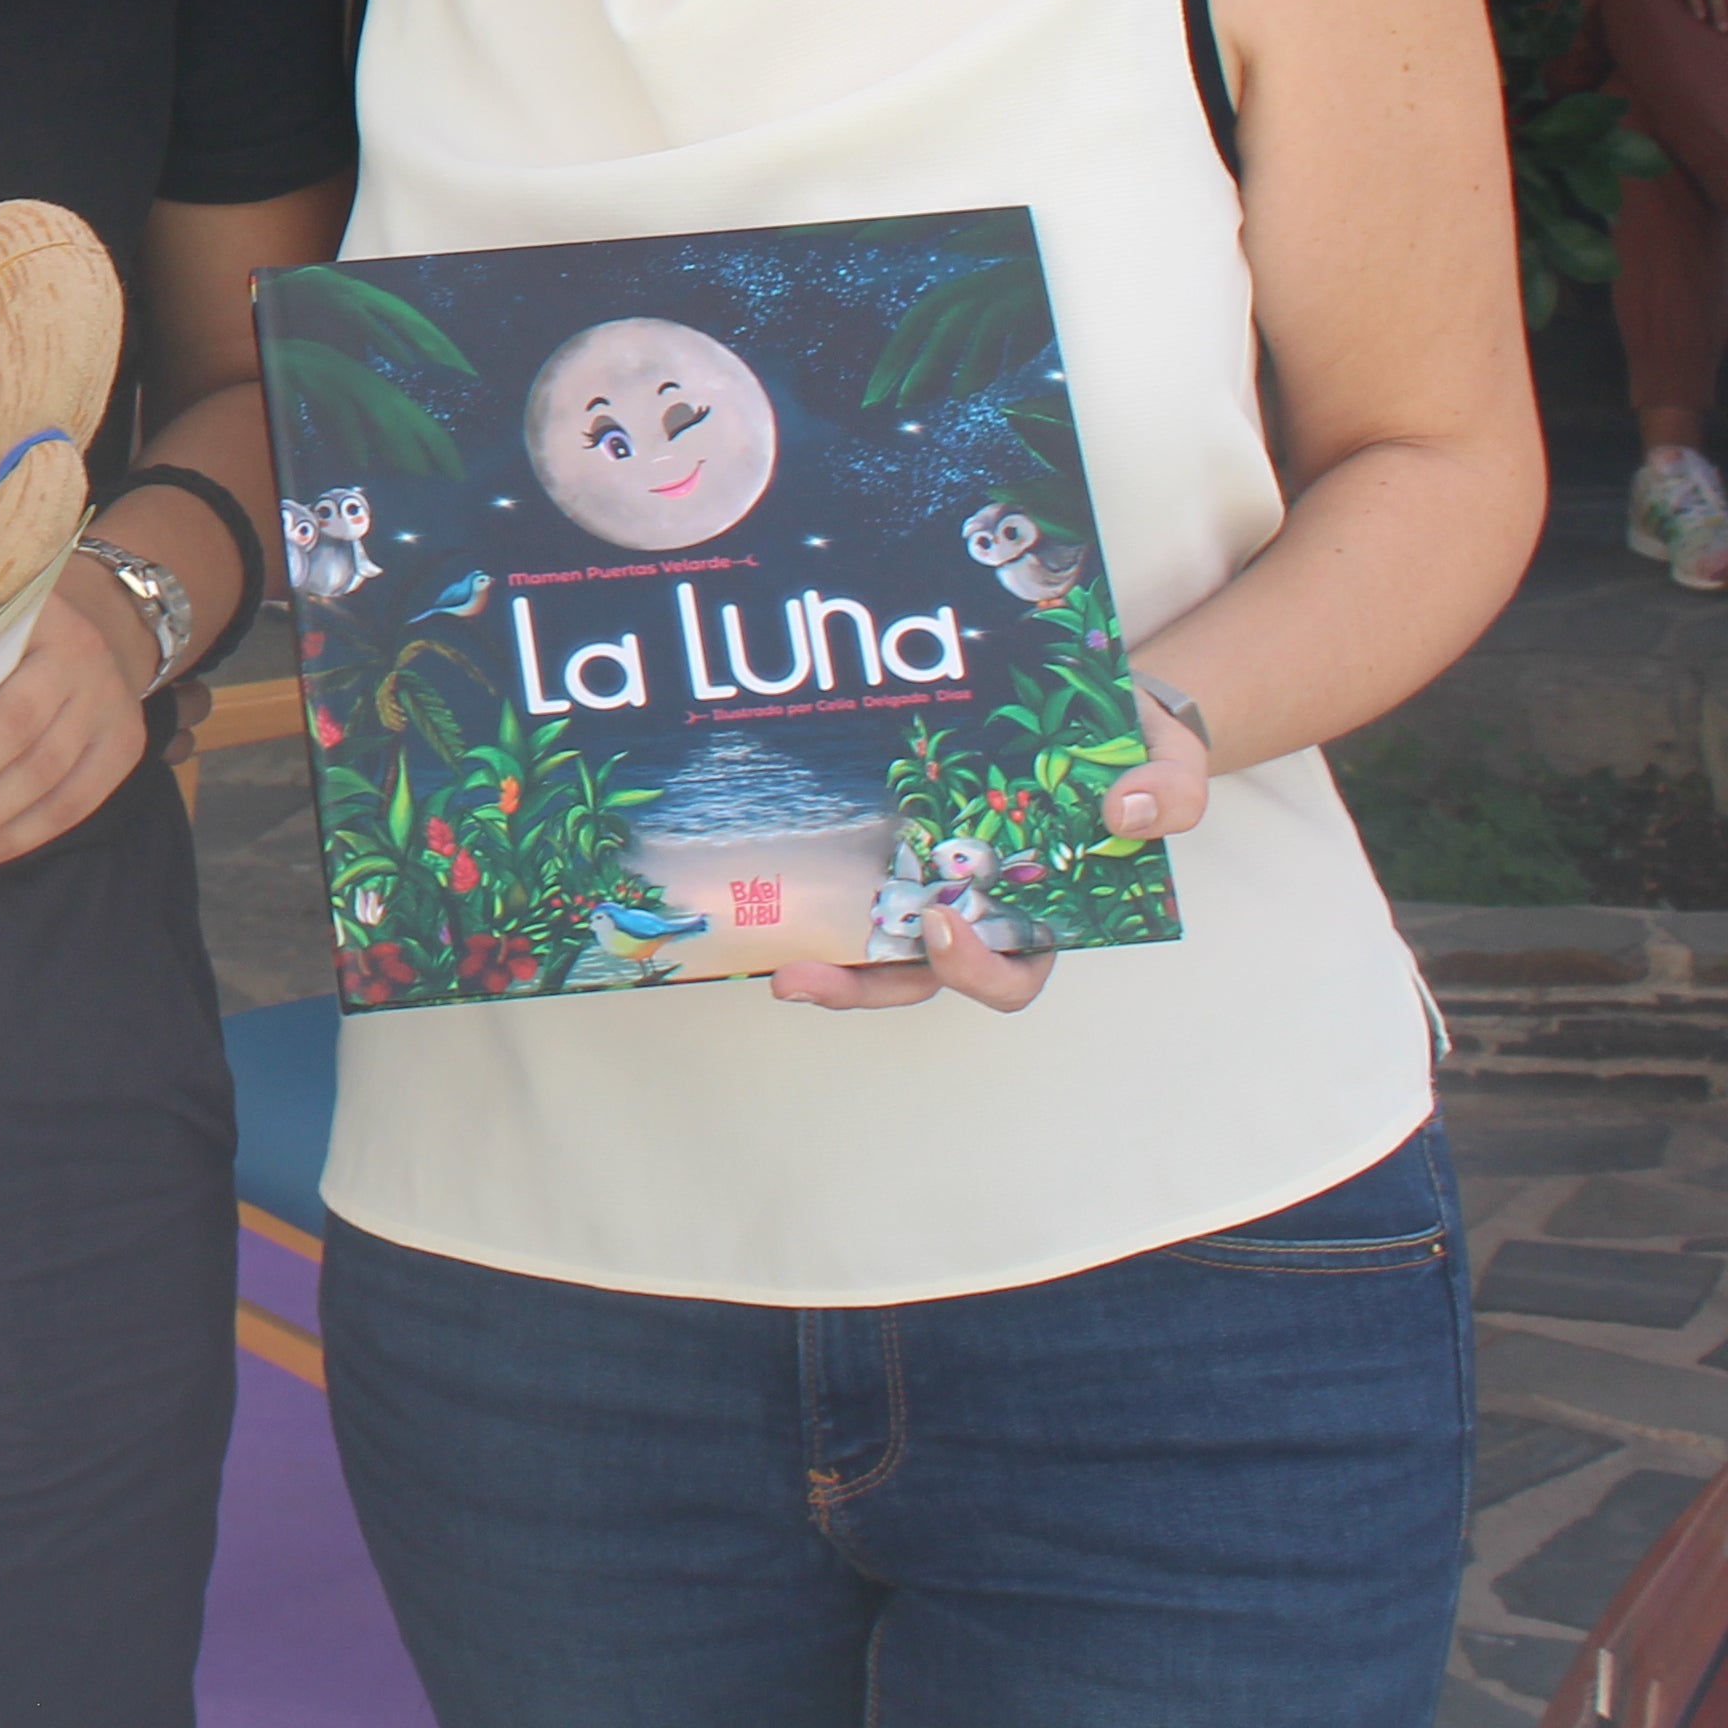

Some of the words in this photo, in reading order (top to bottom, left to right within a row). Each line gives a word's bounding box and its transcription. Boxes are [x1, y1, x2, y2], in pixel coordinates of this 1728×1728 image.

[512, 595, 648, 716] La
[676, 581, 966, 701] Luna
[787, 702, 814, 717] por
